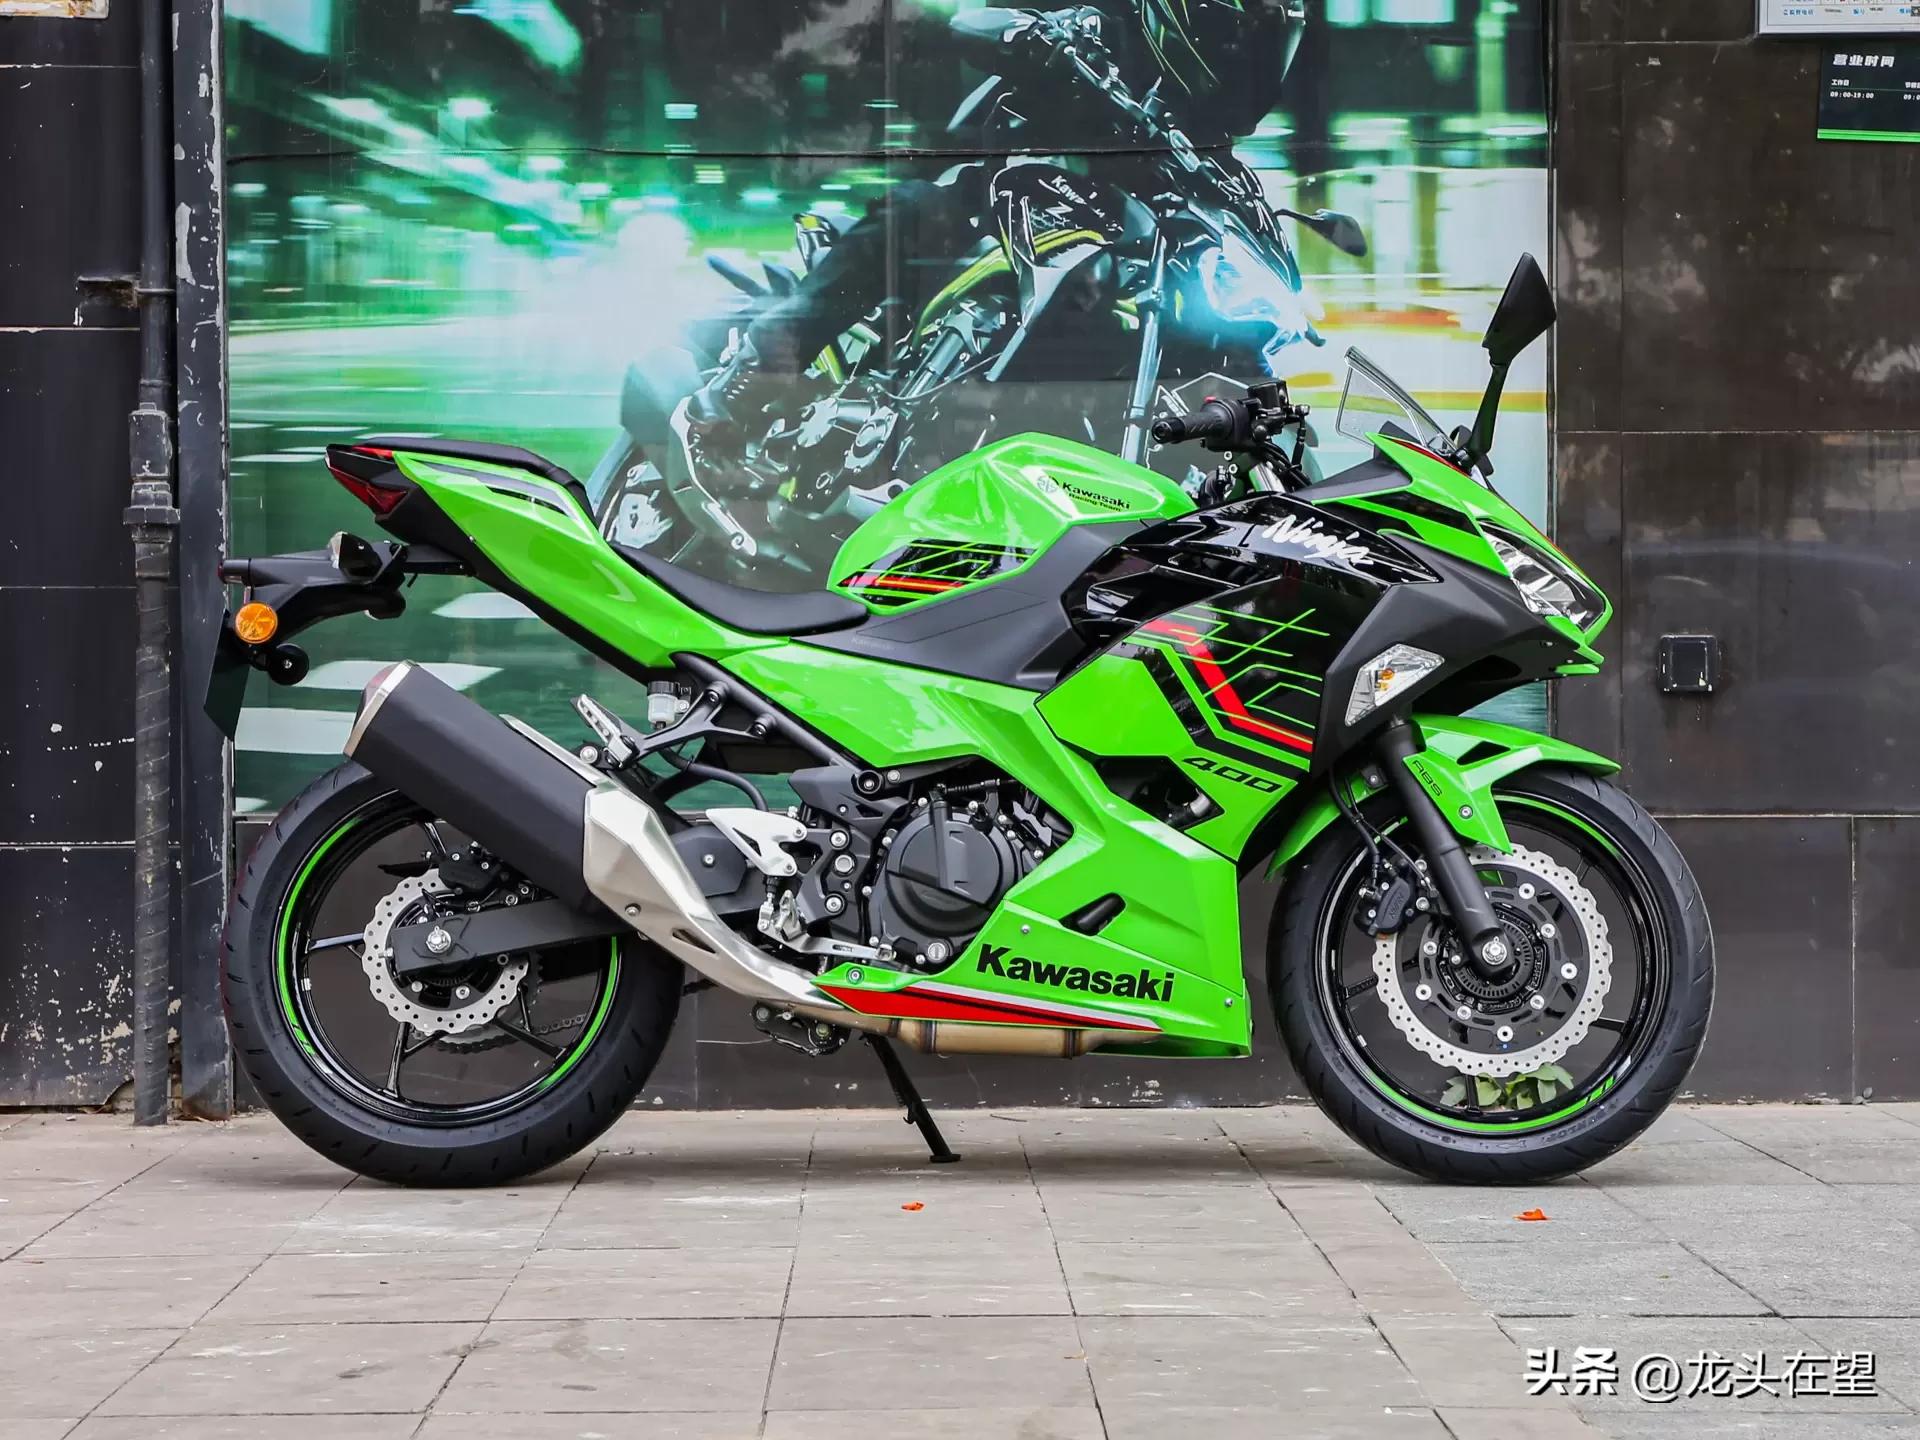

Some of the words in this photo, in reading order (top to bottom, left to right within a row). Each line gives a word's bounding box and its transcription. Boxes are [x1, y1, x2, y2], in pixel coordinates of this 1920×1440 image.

[1833, 54, 1895, 67] 营业时间
[1062, 482, 1130, 510] Kawasaki
[1068, 492, 1098, 506] Racing
[1099, 501, 1122, 512] Team
[1262, 514, 1374, 566] Ninja
[1182, 757, 1283, 793] 400
[1411, 760, 1443, 797] ABS
[976, 943, 1175, 1003] Kawasaki
